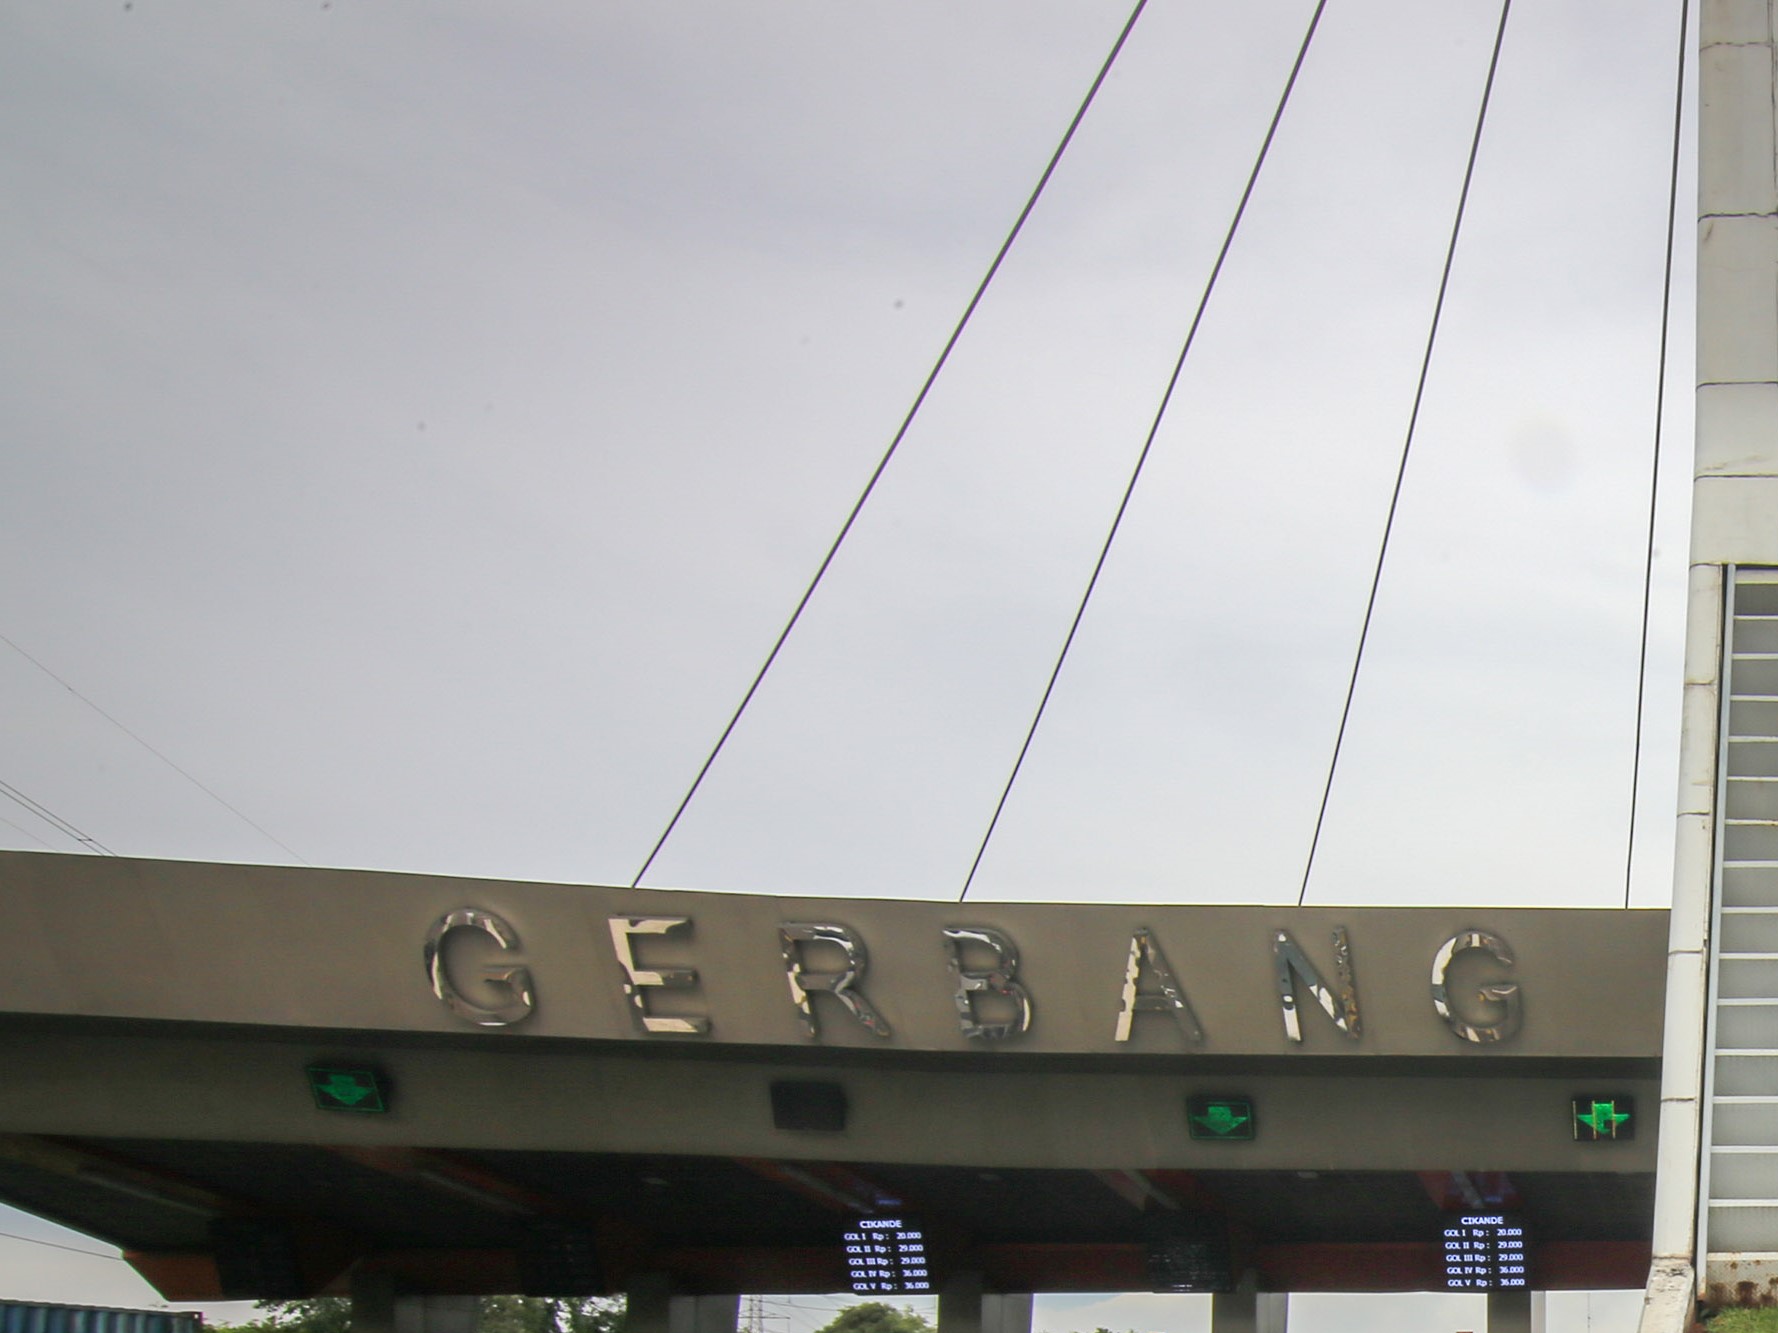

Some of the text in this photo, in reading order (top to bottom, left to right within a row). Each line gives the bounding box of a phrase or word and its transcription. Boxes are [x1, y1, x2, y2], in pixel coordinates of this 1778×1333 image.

[424, 906, 1523, 1044] GERBANG
[860, 1220, 902, 1228] CIKANDE
[1461, 1216, 1503, 1224] CIKANDE
